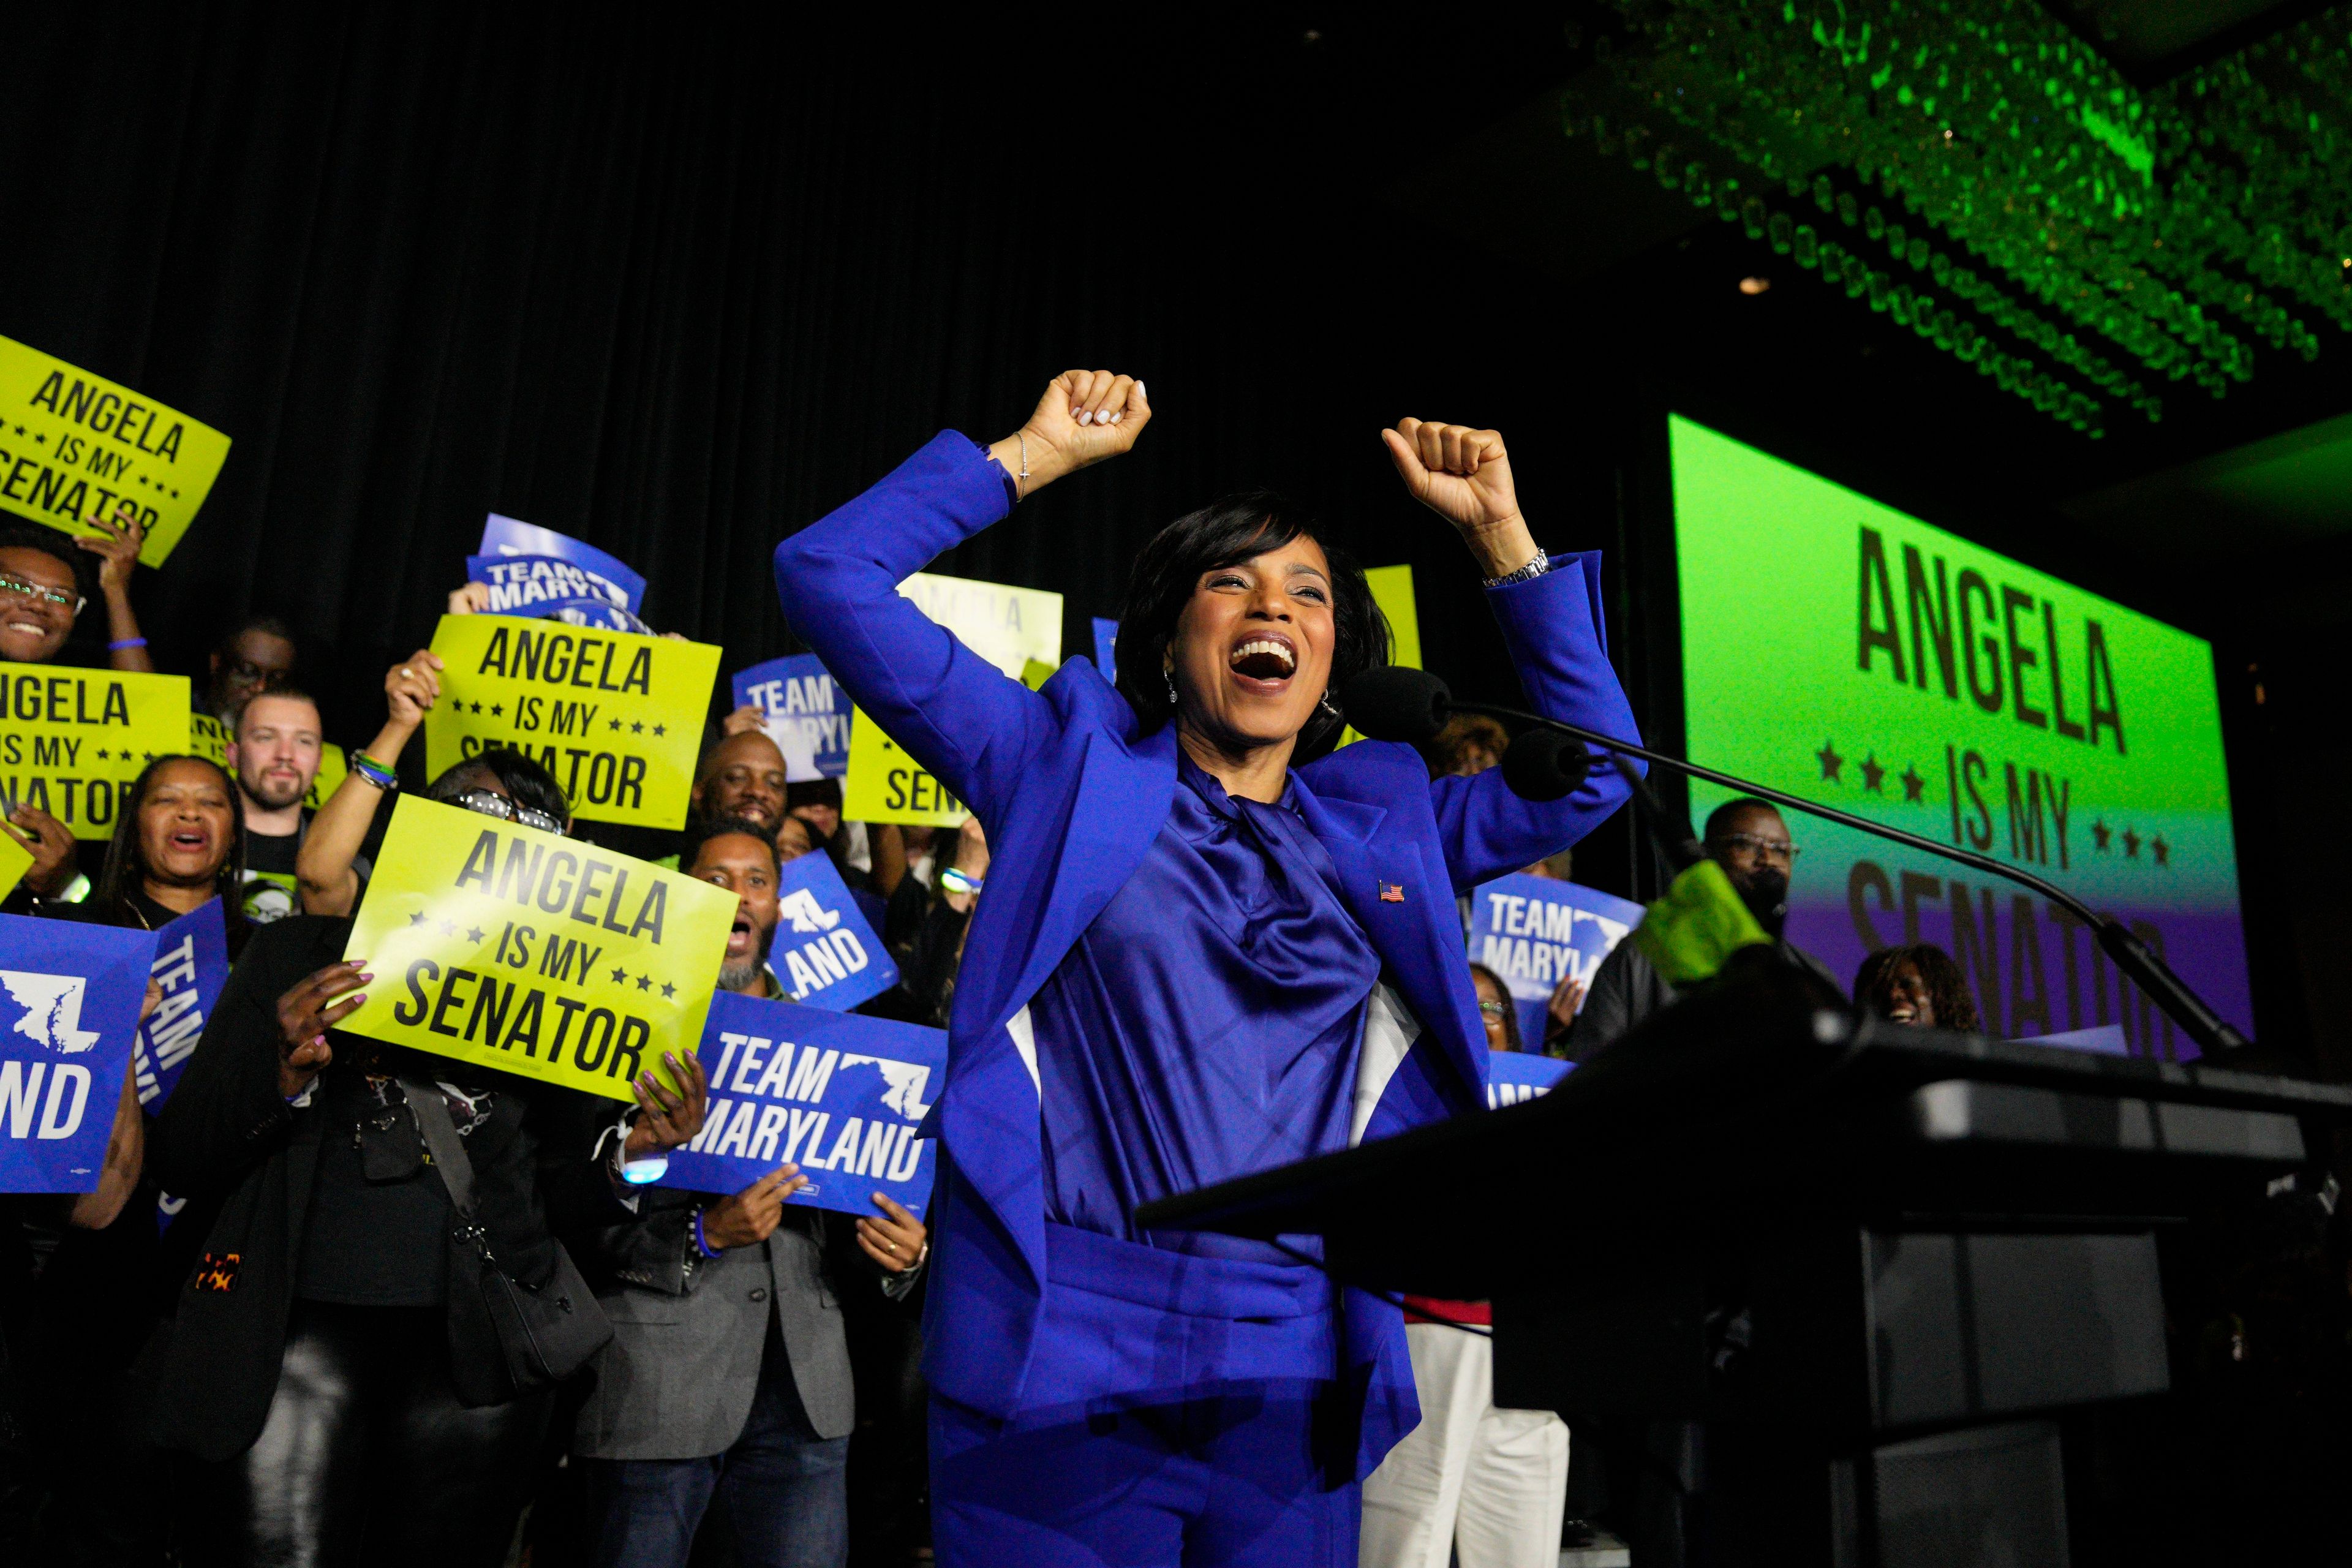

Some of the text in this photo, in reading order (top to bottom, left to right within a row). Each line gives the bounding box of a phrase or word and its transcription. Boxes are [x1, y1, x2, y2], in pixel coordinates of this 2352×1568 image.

[30, 369, 185, 464] ANGELA
[55, 432, 133, 482] IS MY
[486, 560, 586, 584] TEAM
[478, 627, 652, 696] ANGELA
[1856, 522, 2127, 756] ANGELA
[514, 696, 598, 737] IS MY
[746, 674, 835, 716] TEAM
[34, 736, 82, 767] MY
[460, 735, 647, 809] ATOR
[886, 768, 967, 813] SEN
[1945, 744, 2070, 871] IS MY
[454, 829, 669, 945] ANGELA
[1488, 892, 1573, 944] TEAM
[495, 921, 603, 986] IS MY
[394, 959, 650, 1082] SENATOR
[0, 1060, 91, 1140] ND
[710, 1031, 840, 1103] TEAM
[676, 1097, 924, 1183] MARYLAND
